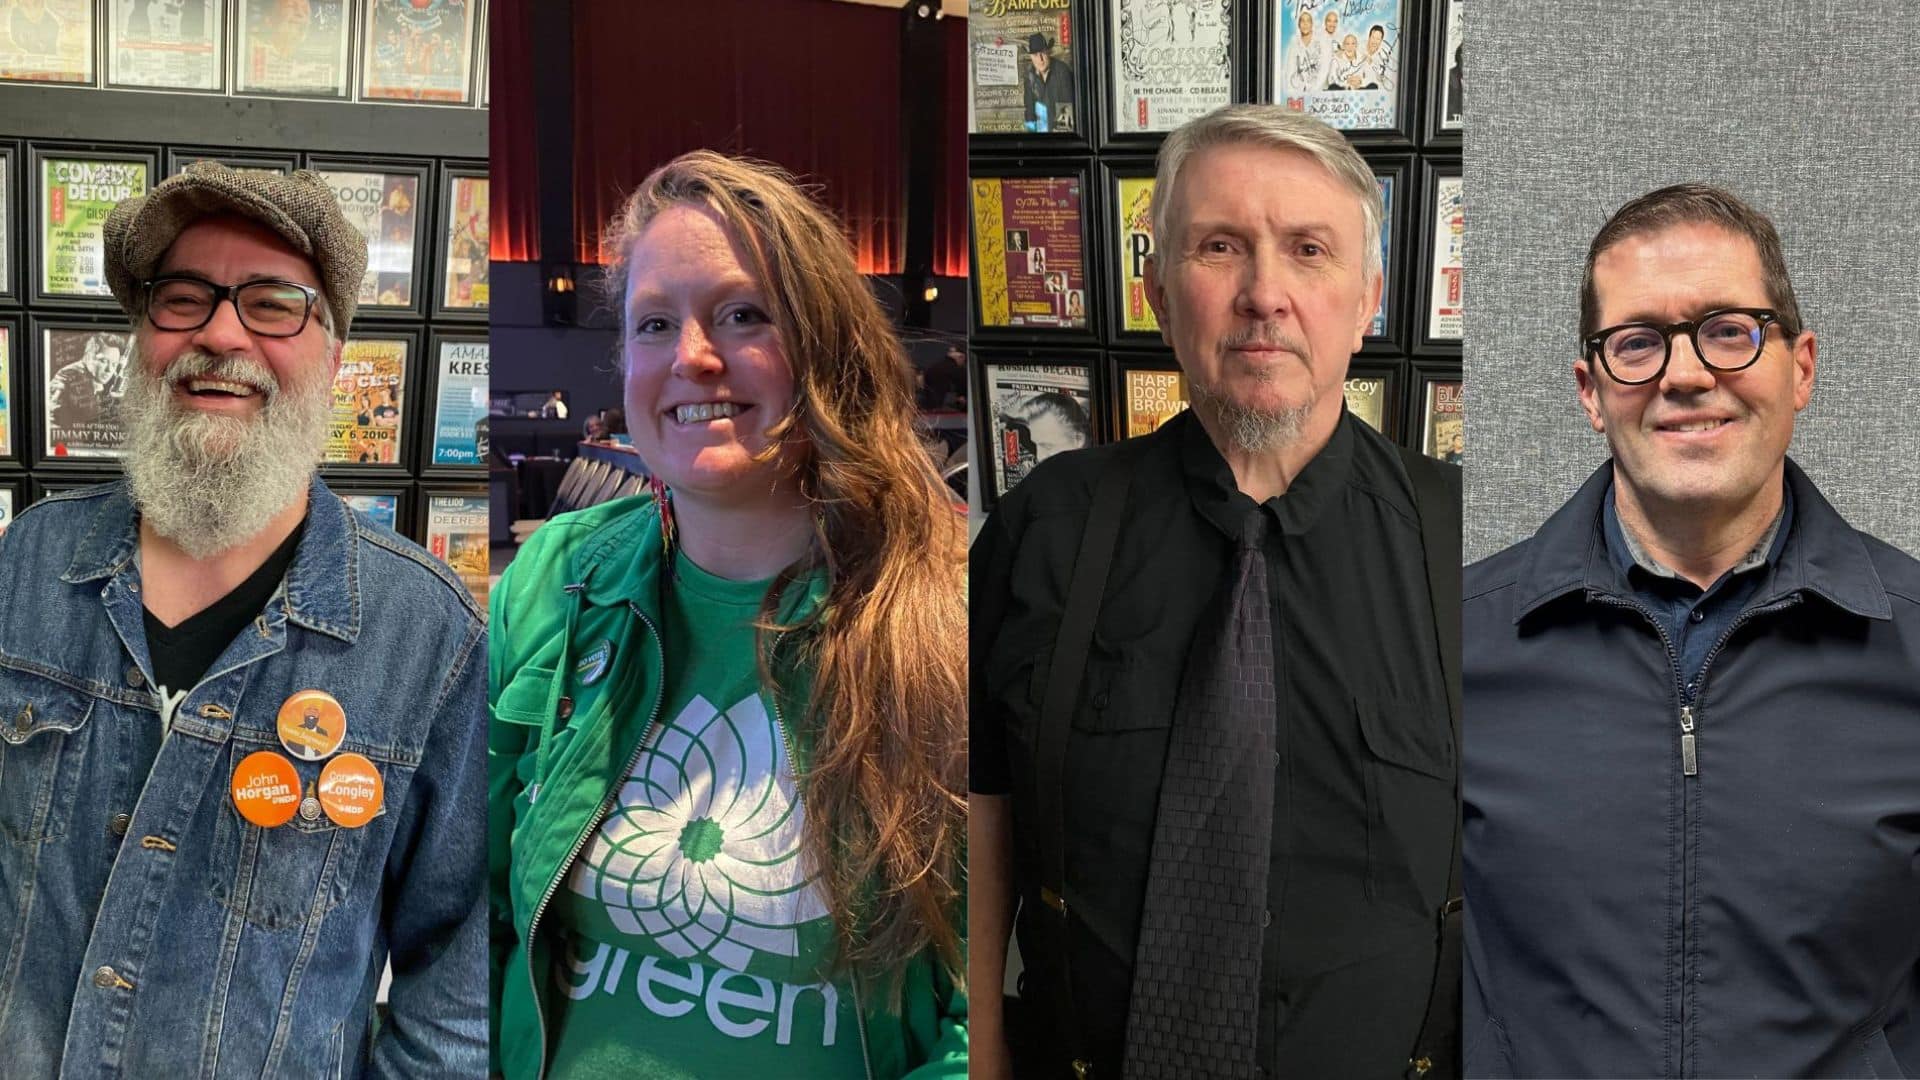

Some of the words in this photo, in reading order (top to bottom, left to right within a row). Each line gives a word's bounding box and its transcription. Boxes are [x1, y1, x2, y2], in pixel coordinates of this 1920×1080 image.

[1142, 87, 1153, 95] THE
[1155, 87, 1183, 95] CHANGE
[1201, 86, 1228, 94] RELEASE
[68, 183, 131, 203] DETOUR
[450, 345, 489, 360] AMA
[1133, 373, 1178, 387] HARP
[1133, 386, 1168, 400] DOG
[1134, 399, 1191, 414] BROWN
[52, 430, 90, 441] JIMMY
[349, 430, 356, 439] 6
[362, 431, 388, 439] 2010
[438, 448, 474, 460] 7:00pm
[246, 773, 279, 788] John
[236, 784, 290, 802] Horgan
[328, 784, 376, 801] Longley
[556, 940, 839, 1048] green
